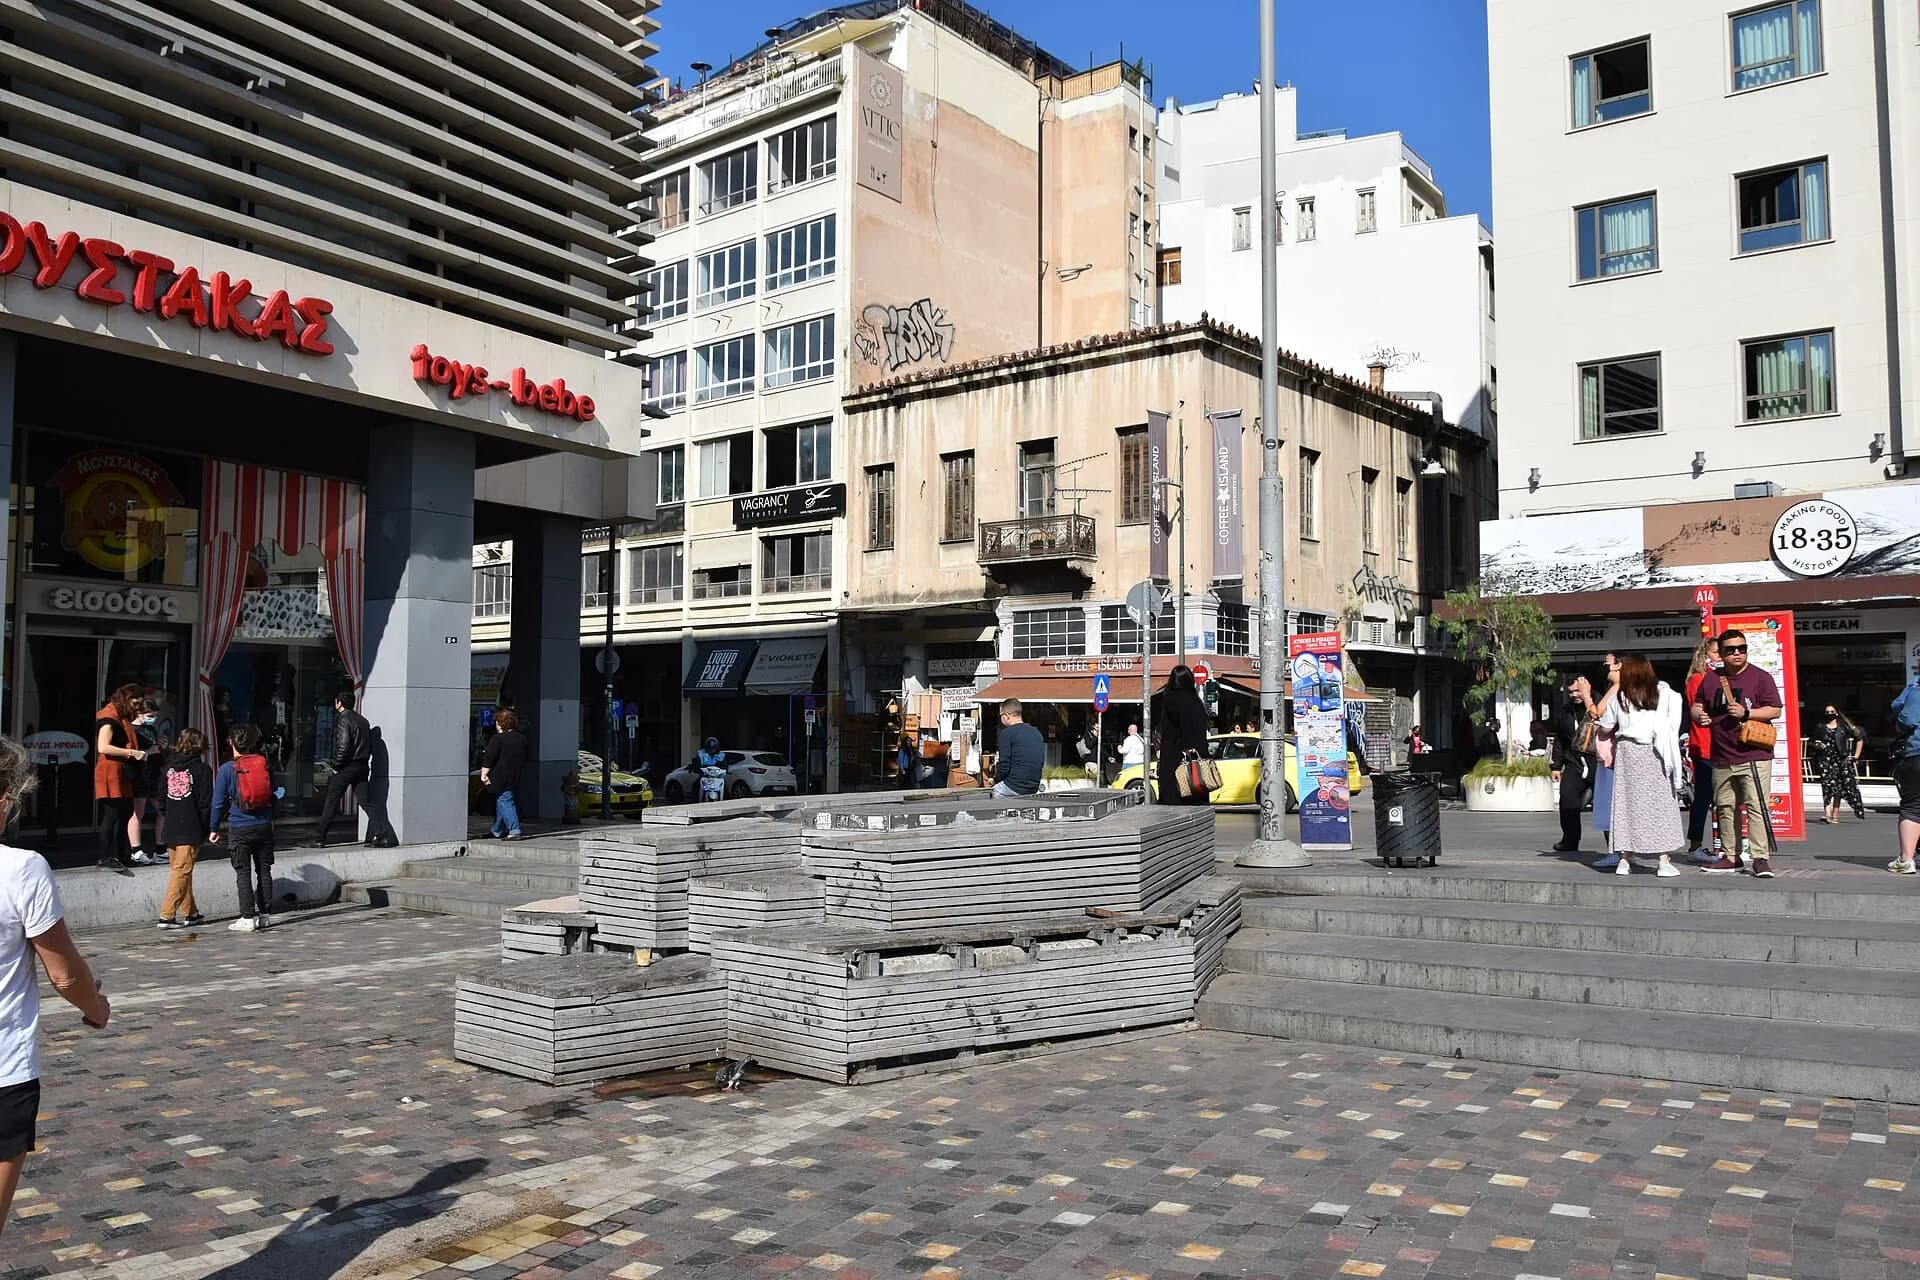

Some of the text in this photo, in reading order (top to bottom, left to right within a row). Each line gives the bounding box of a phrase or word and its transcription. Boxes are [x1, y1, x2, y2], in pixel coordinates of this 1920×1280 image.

[77, 455, 160, 483] ΜΟΥΣΤΑΚΑΣ
[1153, 445, 1161, 486] SLAND
[740, 493, 789, 511] VAGRANCY
[1218, 446, 1230, 545] COFFEE ISLAND
[1780, 505, 1847, 531] MAKING FOOD
[1792, 555, 1839, 570] HISTORY
[1696, 590, 1714, 602] A14
[1634, 627, 1690, 638] YOGURT
[1794, 619, 1859, 631] CE CREAM
[707, 652, 738, 665] LIQUID
[1054, 658, 1133, 672] COFFEE ISLAND
[700, 665, 732, 680] PUFF
